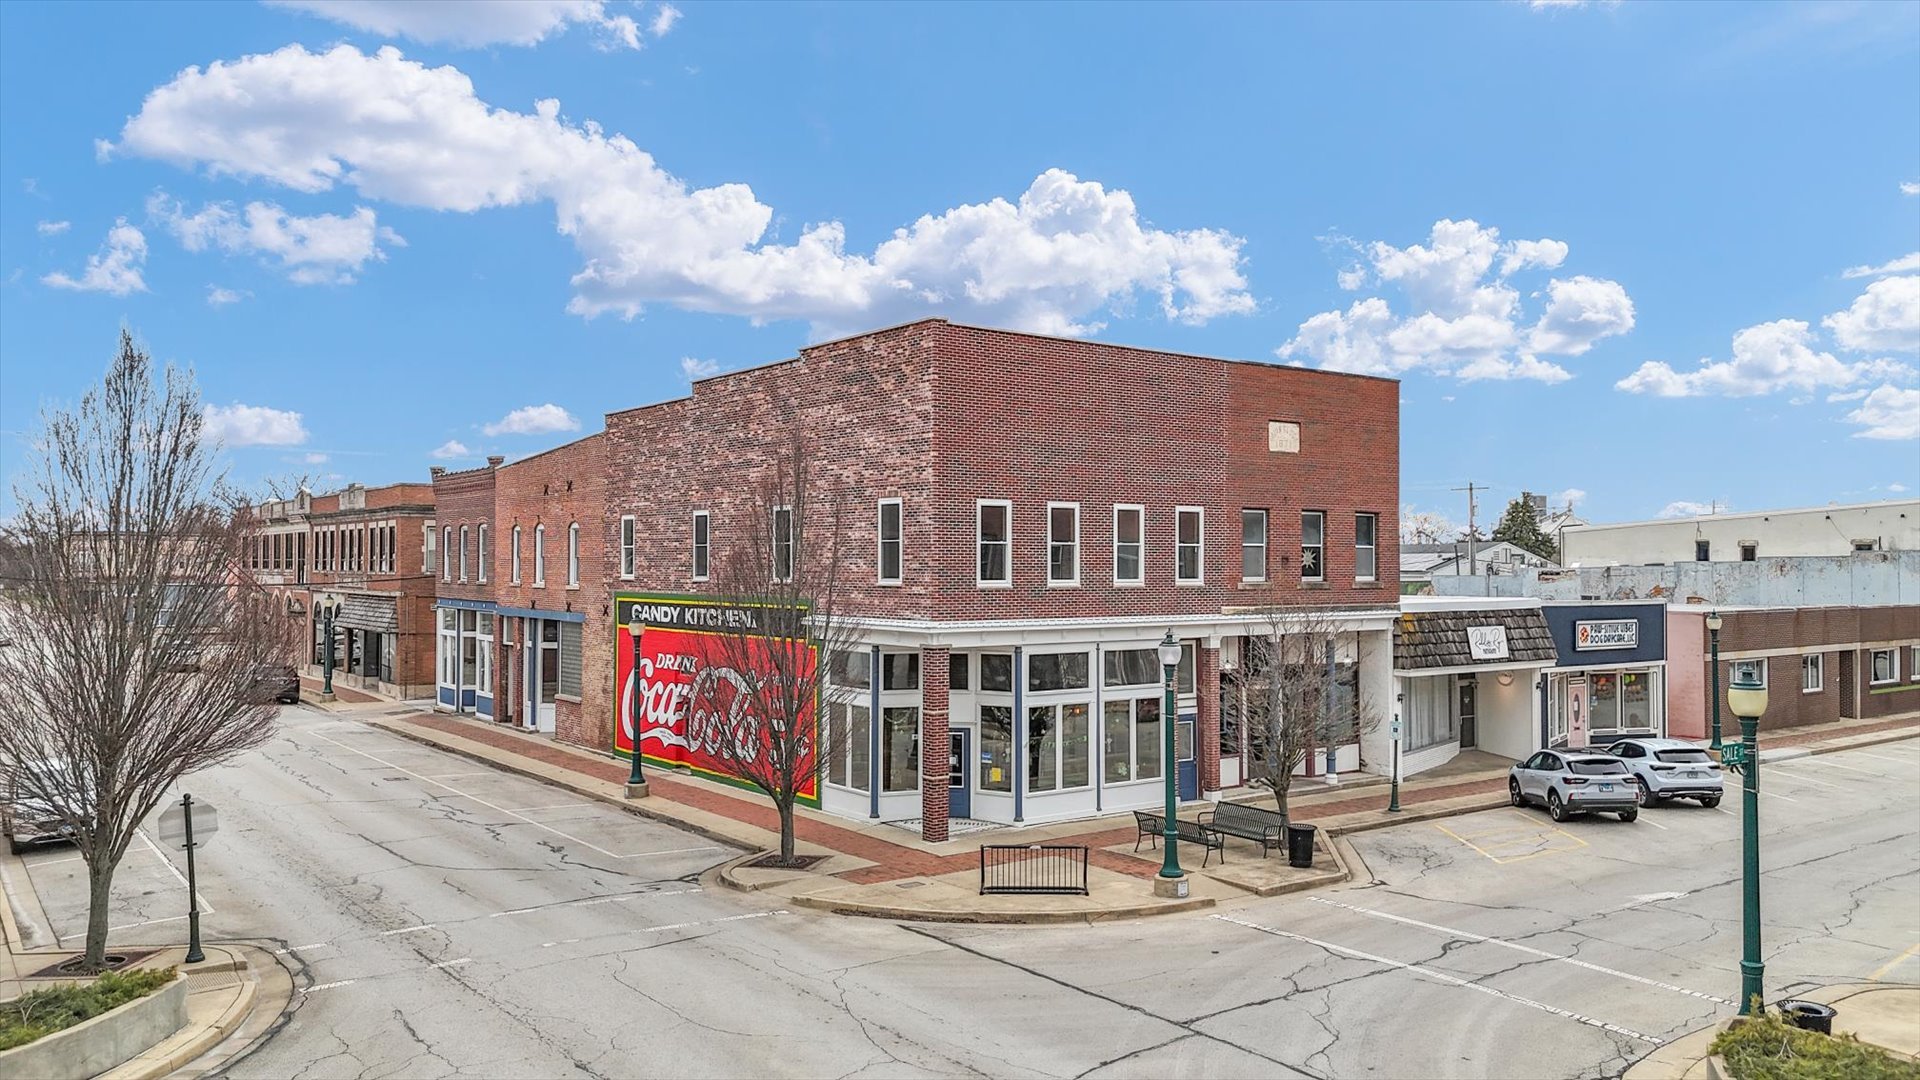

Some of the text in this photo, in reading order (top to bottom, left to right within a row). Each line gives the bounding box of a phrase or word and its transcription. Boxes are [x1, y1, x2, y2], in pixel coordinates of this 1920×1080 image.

[631, 603, 681, 624] CANDY
[1590, 634, 1603, 644] DOG
[655, 653, 698, 673] DRINK
[1723, 745, 1738, 762] SALE
